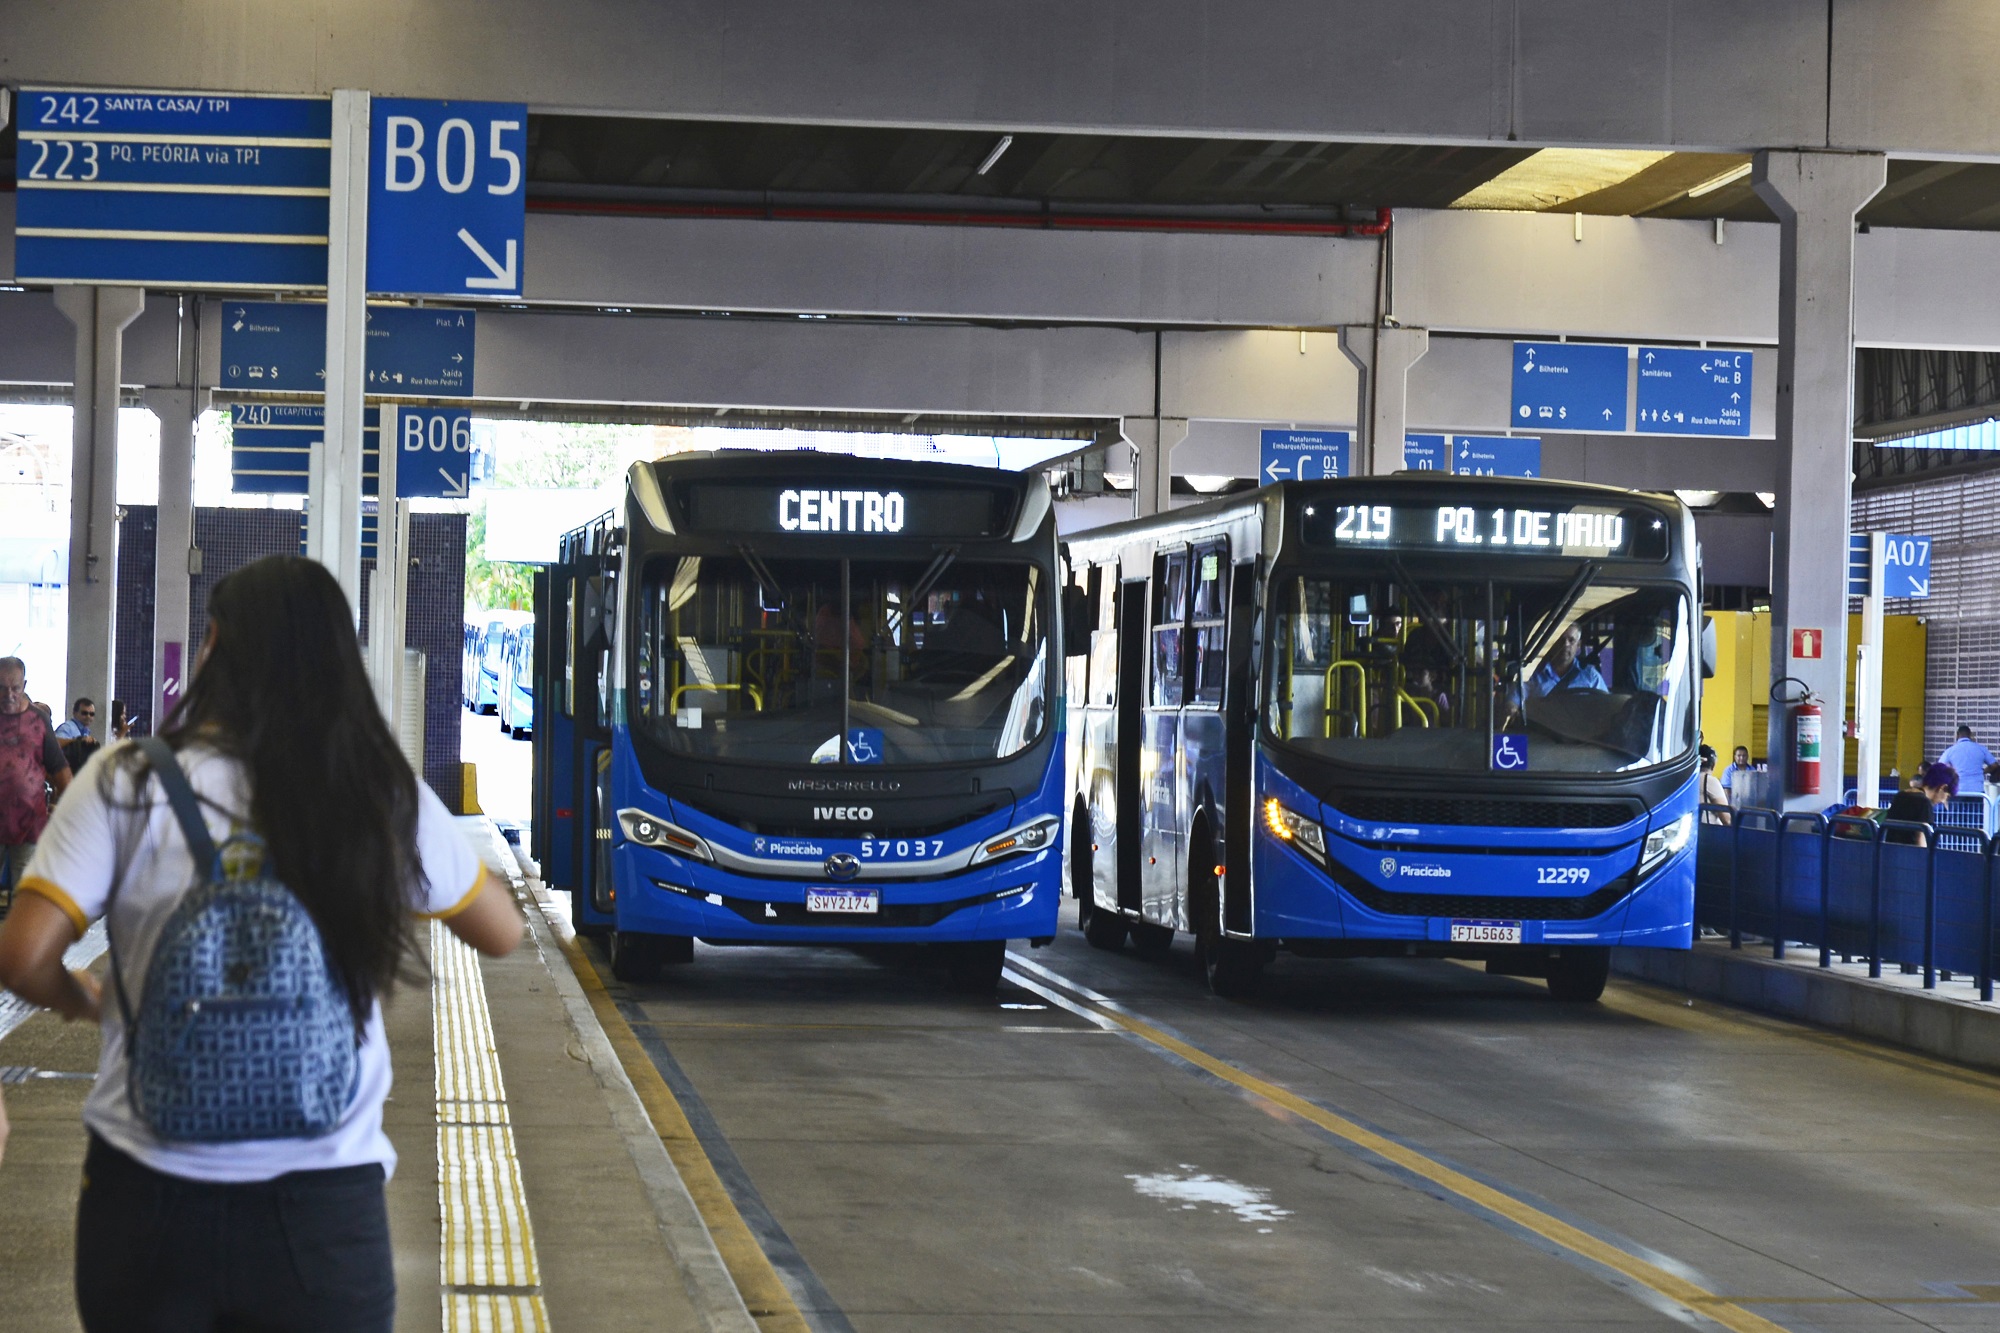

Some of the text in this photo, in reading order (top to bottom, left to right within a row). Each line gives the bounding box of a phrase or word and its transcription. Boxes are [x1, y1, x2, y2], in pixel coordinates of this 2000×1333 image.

[40, 96, 230, 125] 242 SANTA CASA/ TPI
[28, 140, 261, 181] 223 PQ. PEÓRIA via TPI
[385, 115, 522, 196] B05
[436, 314, 465, 327] Plat. A
[249, 324, 280, 333] Bilheteria
[366, 329, 390, 337] nitários
[1714, 355, 1741, 369] Plat. C
[442, 368, 463, 378] Saída
[1539, 365, 1569, 374] Bilheteria
[1642, 369, 1672, 378] Sanitários
[410, 377, 423, 385] Rua
[424, 377, 439, 386] Dom
[440, 378, 458, 387] Pedro
[1713, 371, 1741, 385] Plat. B
[236, 405, 271, 425] 240
[274, 406, 312, 417] CECAP/TCI
[1721, 408, 1741, 418] Saída
[1691, 416, 1703, 425] Rua
[1704, 417, 1718, 425] Dom
[1719, 417, 1737, 426] Pedro
[404, 414, 470, 452] B06
[1289, 435, 1323, 443] Plataformas
[1272, 442, 1339, 452] Embarque/Desembarque
[1323, 455, 1338, 470] 01
[1472, 452, 1495, 460] Bilheteria
[1418, 458, 1433, 470] 01
[779, 489, 905, 532] CENTRO
[1335, 505, 1623, 548] 219 PQ. 1 DE MAIO
[1884, 539, 1929, 567] A07
[788, 778, 901, 791] MASCARELLO
[813, 806, 874, 821] IVECO
[770, 843, 823, 856] Piracicaba
[861, 840, 944, 858] 57037
[1400, 865, 1452, 878] Piracicaba
[1537, 867, 1590, 884] 12299
[1457, 926, 1514, 941] FTL5G63
